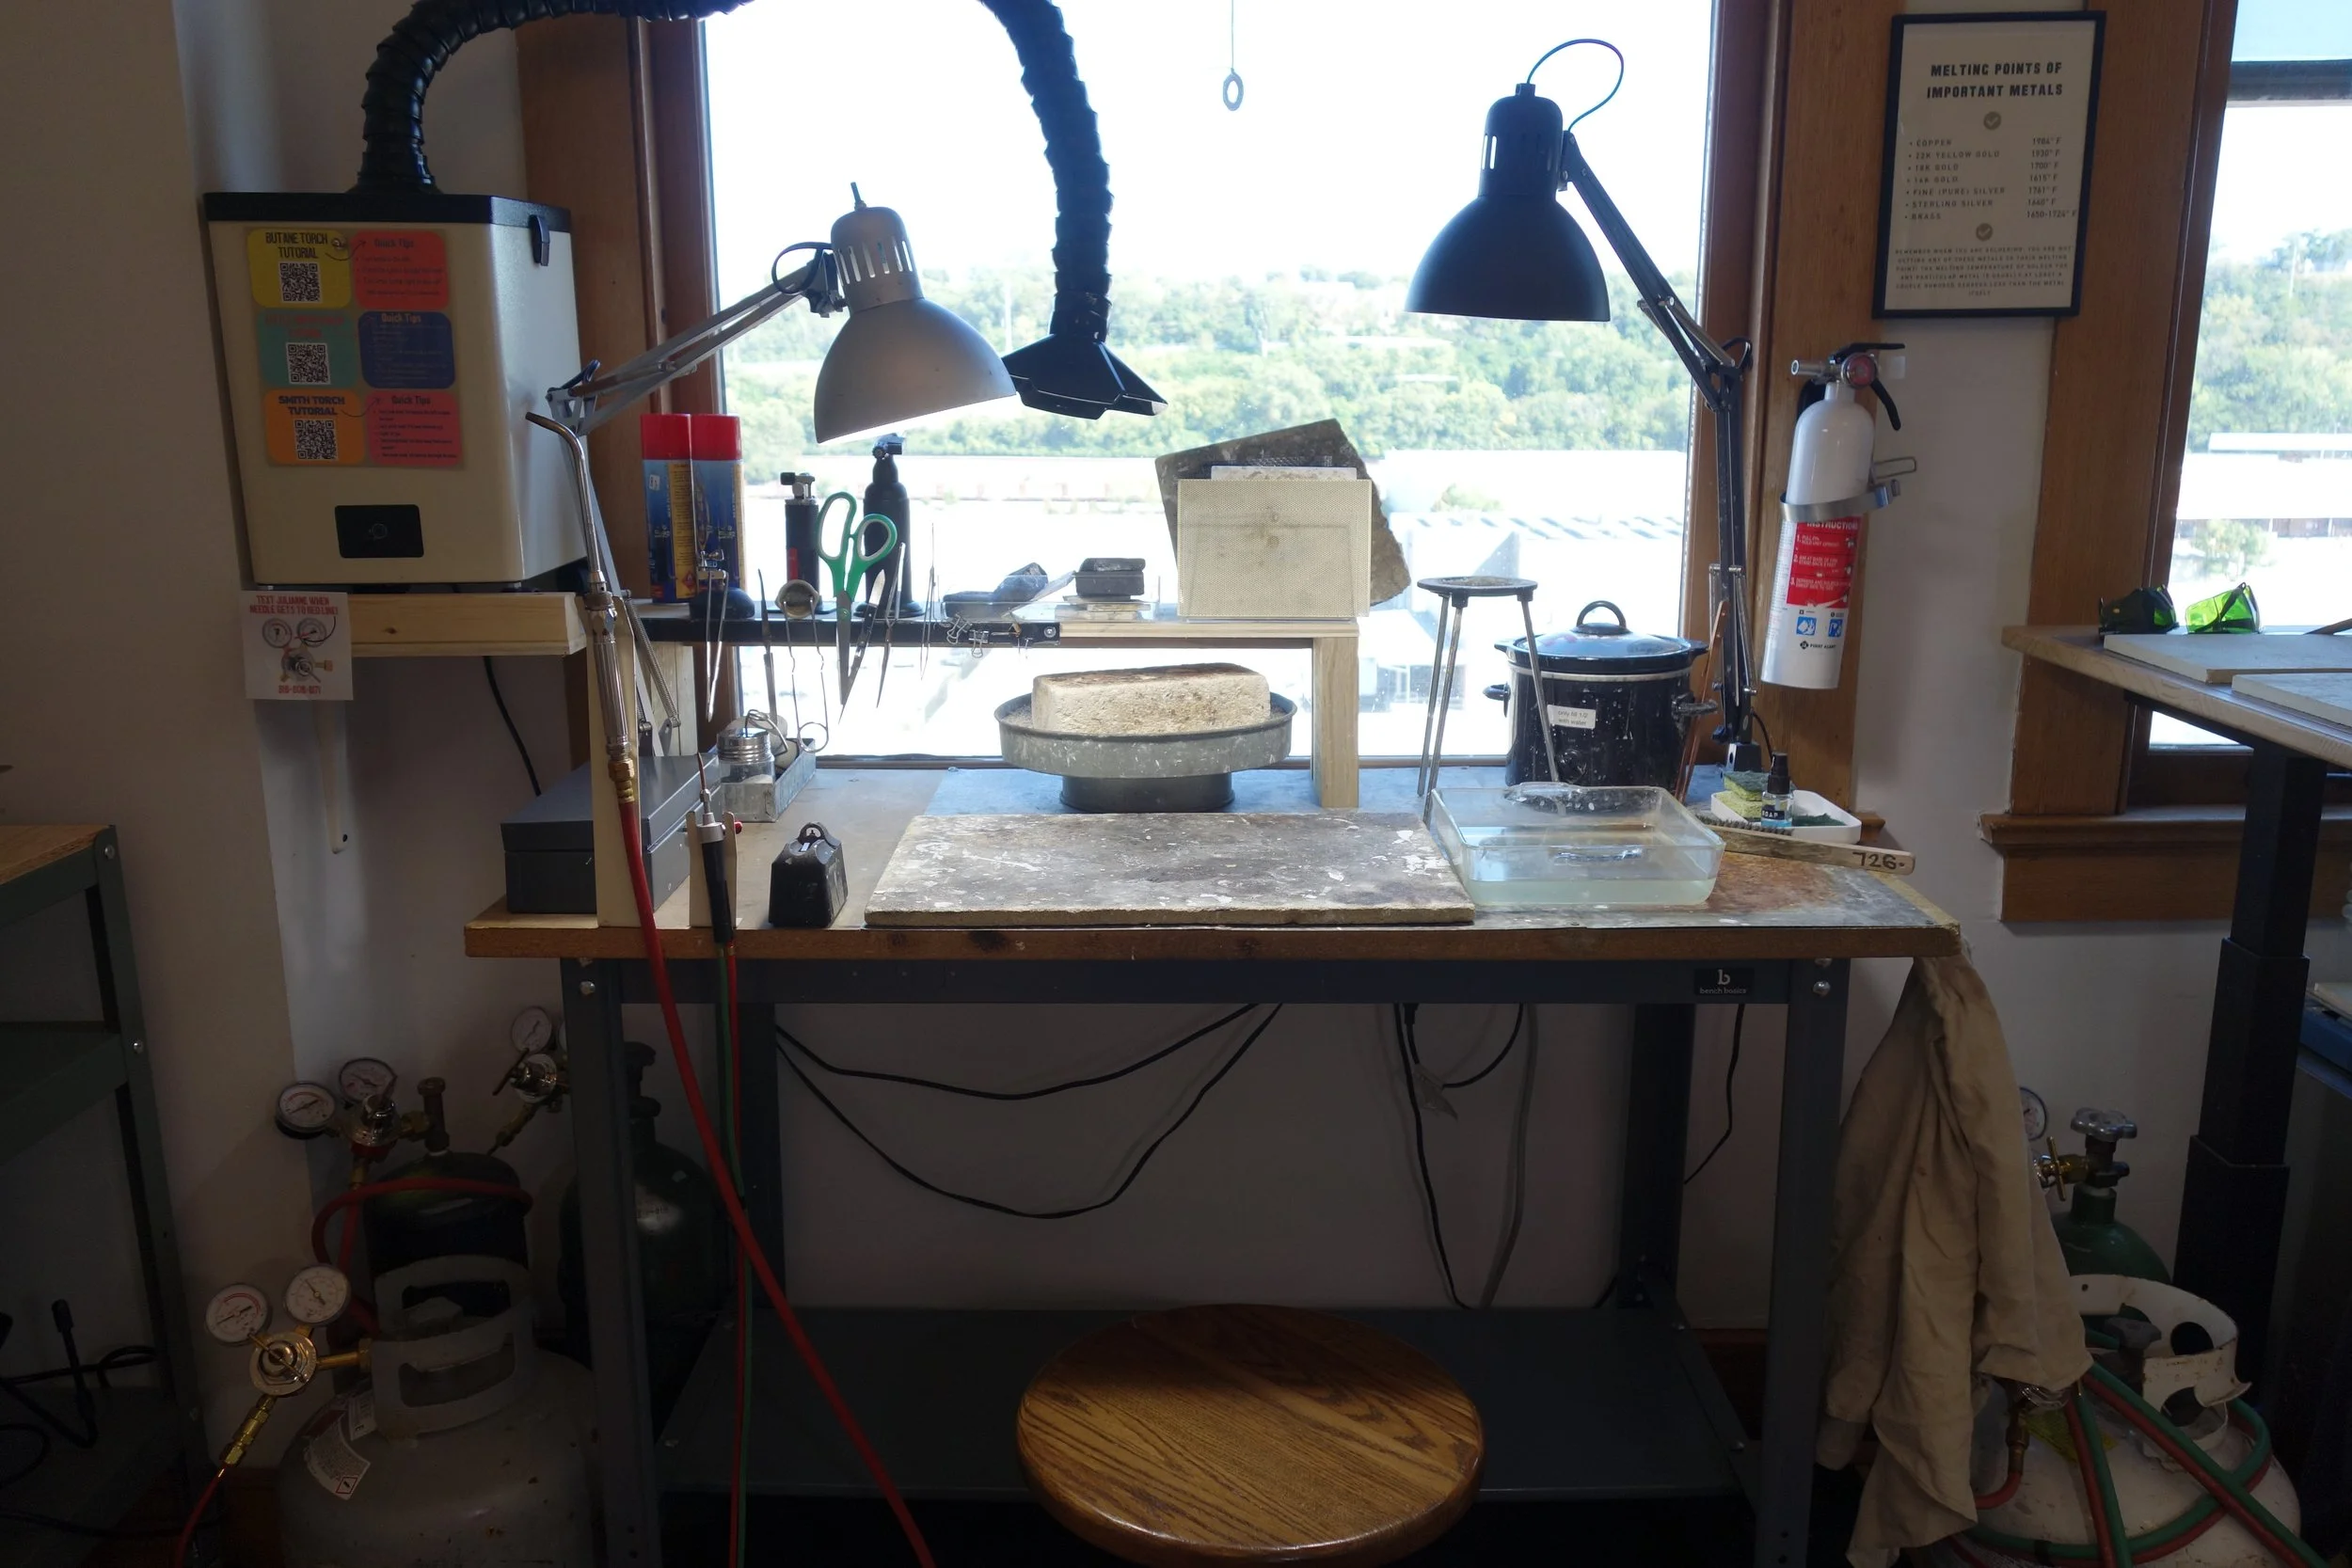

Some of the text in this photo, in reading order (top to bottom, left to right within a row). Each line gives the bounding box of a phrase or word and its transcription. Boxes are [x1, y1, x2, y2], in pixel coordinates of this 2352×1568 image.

[1931, 61, 2062, 76] MELTING POINTS OF
[1927, 84, 2063, 99] IMPORTANT METALS
[2056, 136, 2062, 145] F
[2055, 149, 2060, 157] F
[2053, 173, 2058, 182] F
[2052, 185, 2058, 194] F
[2051, 198, 2057, 206] F
[265, 231, 327, 245] BUTANE TORCH
[373, 237, 414, 249] Quick Tips
[278, 246, 319, 259] TUTORIAL
[381, 312, 421, 325] Quick Tips
[278, 395, 345, 405] SMITH TORCH
[391, 395, 432, 405] Quick Tips
[288, 406, 338, 416] TUTORIAL
[256, 594, 274, 605] TEXT
[309, 596, 329, 607] WHEN
[249, 604, 276, 614] NEEDLE
[277, 605, 294, 614] GETS
[296, 606, 306, 614] TO
[1718, 969, 1730, 985] b
